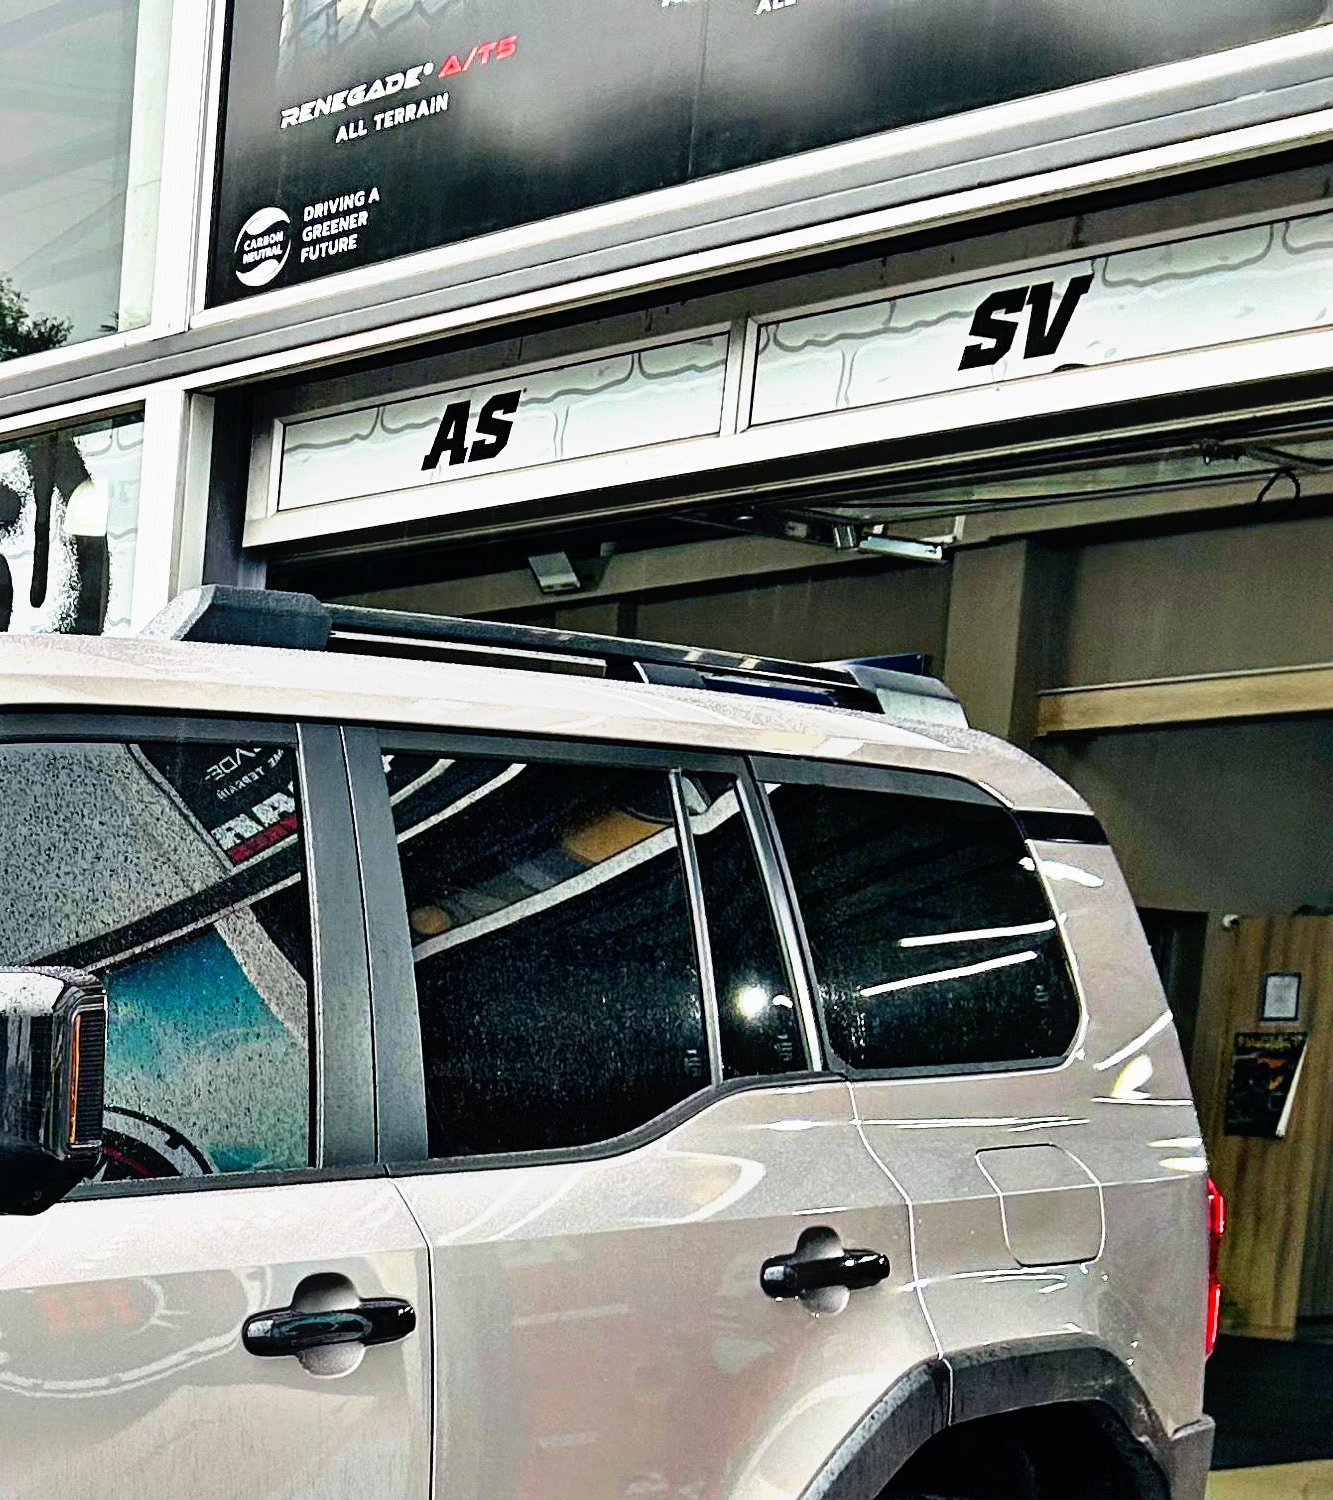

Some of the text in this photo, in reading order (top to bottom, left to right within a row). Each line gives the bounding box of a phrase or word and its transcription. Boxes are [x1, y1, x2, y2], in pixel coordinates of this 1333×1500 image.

[335, 92, 449, 144] ALL TERRAIN
[303, 187, 380, 222] DRIVING A
[243, 230, 284, 251] CARBON
[301, 210, 369, 242] GREENER
[242, 243, 283, 264] NEUTRAL
[300, 233, 358, 263] FUTURE
[957, 273, 1094, 371] SV
[421, 389, 522, 471] AS
